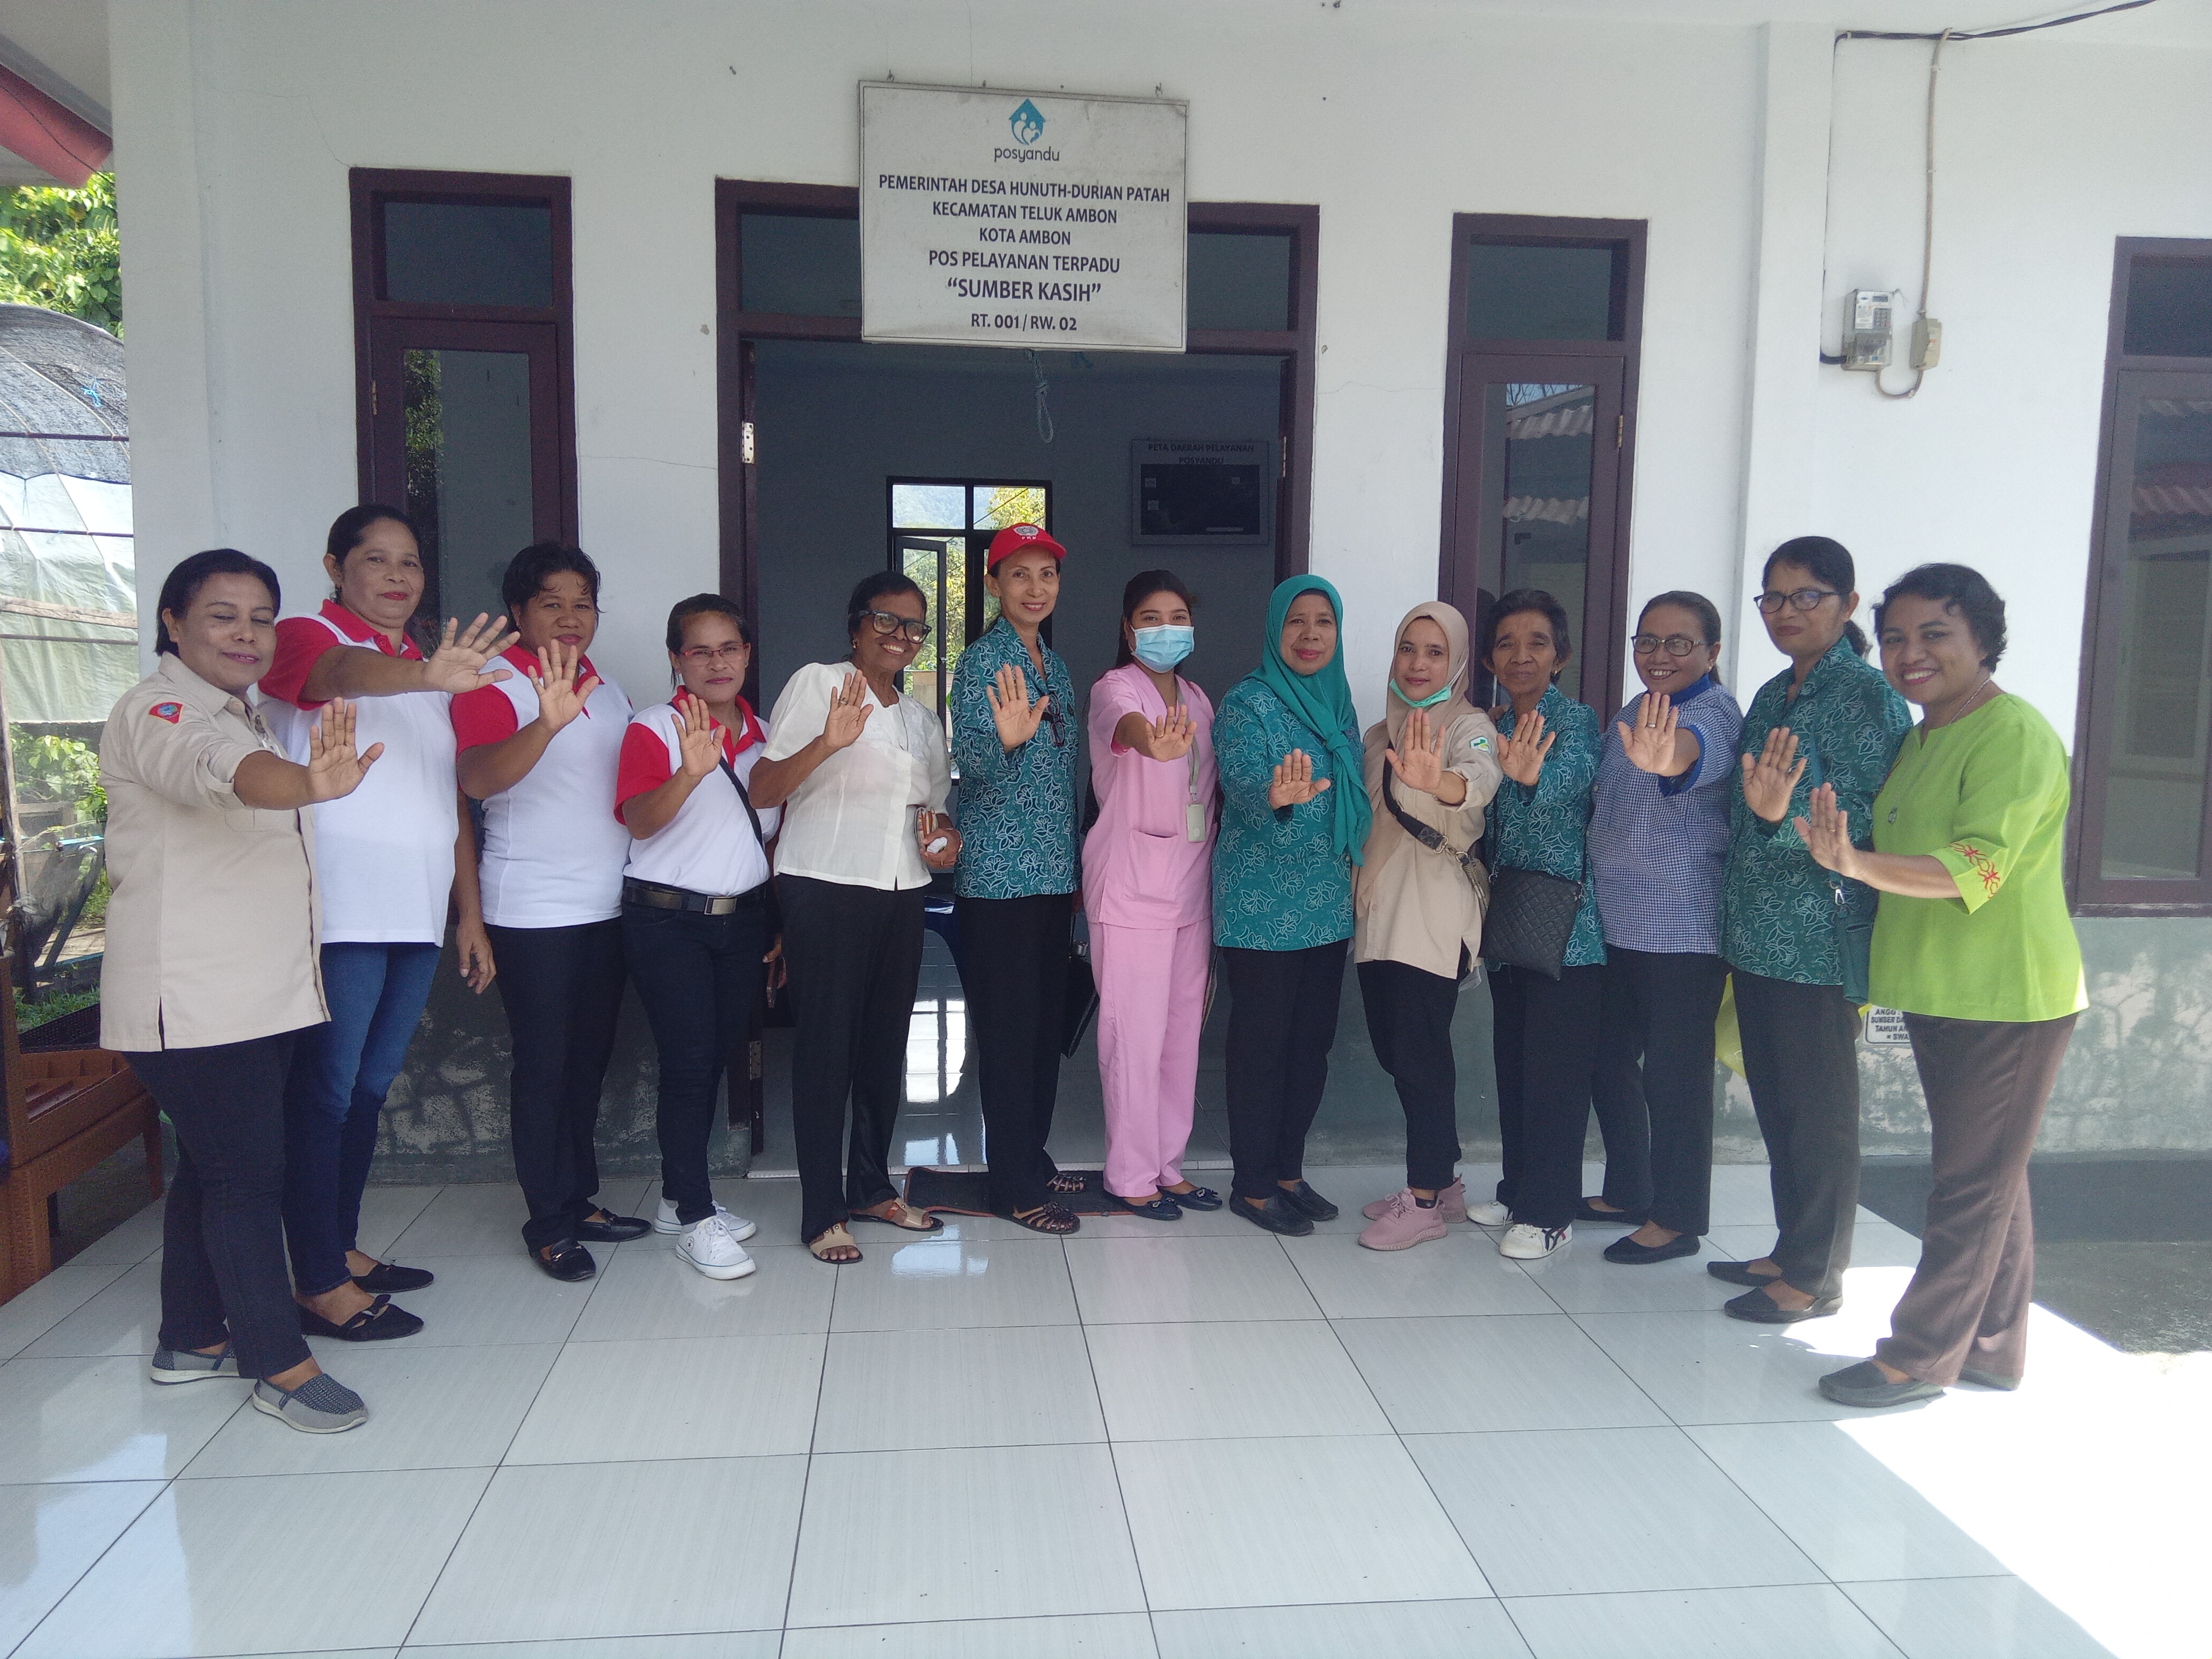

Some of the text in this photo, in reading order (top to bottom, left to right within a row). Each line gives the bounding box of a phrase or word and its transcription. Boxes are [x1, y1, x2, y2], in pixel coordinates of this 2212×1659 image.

[994, 146, 1059, 163] posyandu
[879, 174, 1169, 202] PEMERINTAH DESA HUNUTH-DURIAN PATAH
[933, 202, 1117, 223] KECAMATAN TELUK AMBON
[980, 228, 1070, 245] KOTA AMBON
[929, 250, 1120, 273] POS PELAYANAN TERPADU
[948, 277, 1101, 301] “SUMBER KASIH”
[971, 314, 990, 327] RT.
[1030, 316, 1055, 330] RW.
[1060, 317, 1077, 331] 02
[1170, 443, 1204, 452] DAERAH
